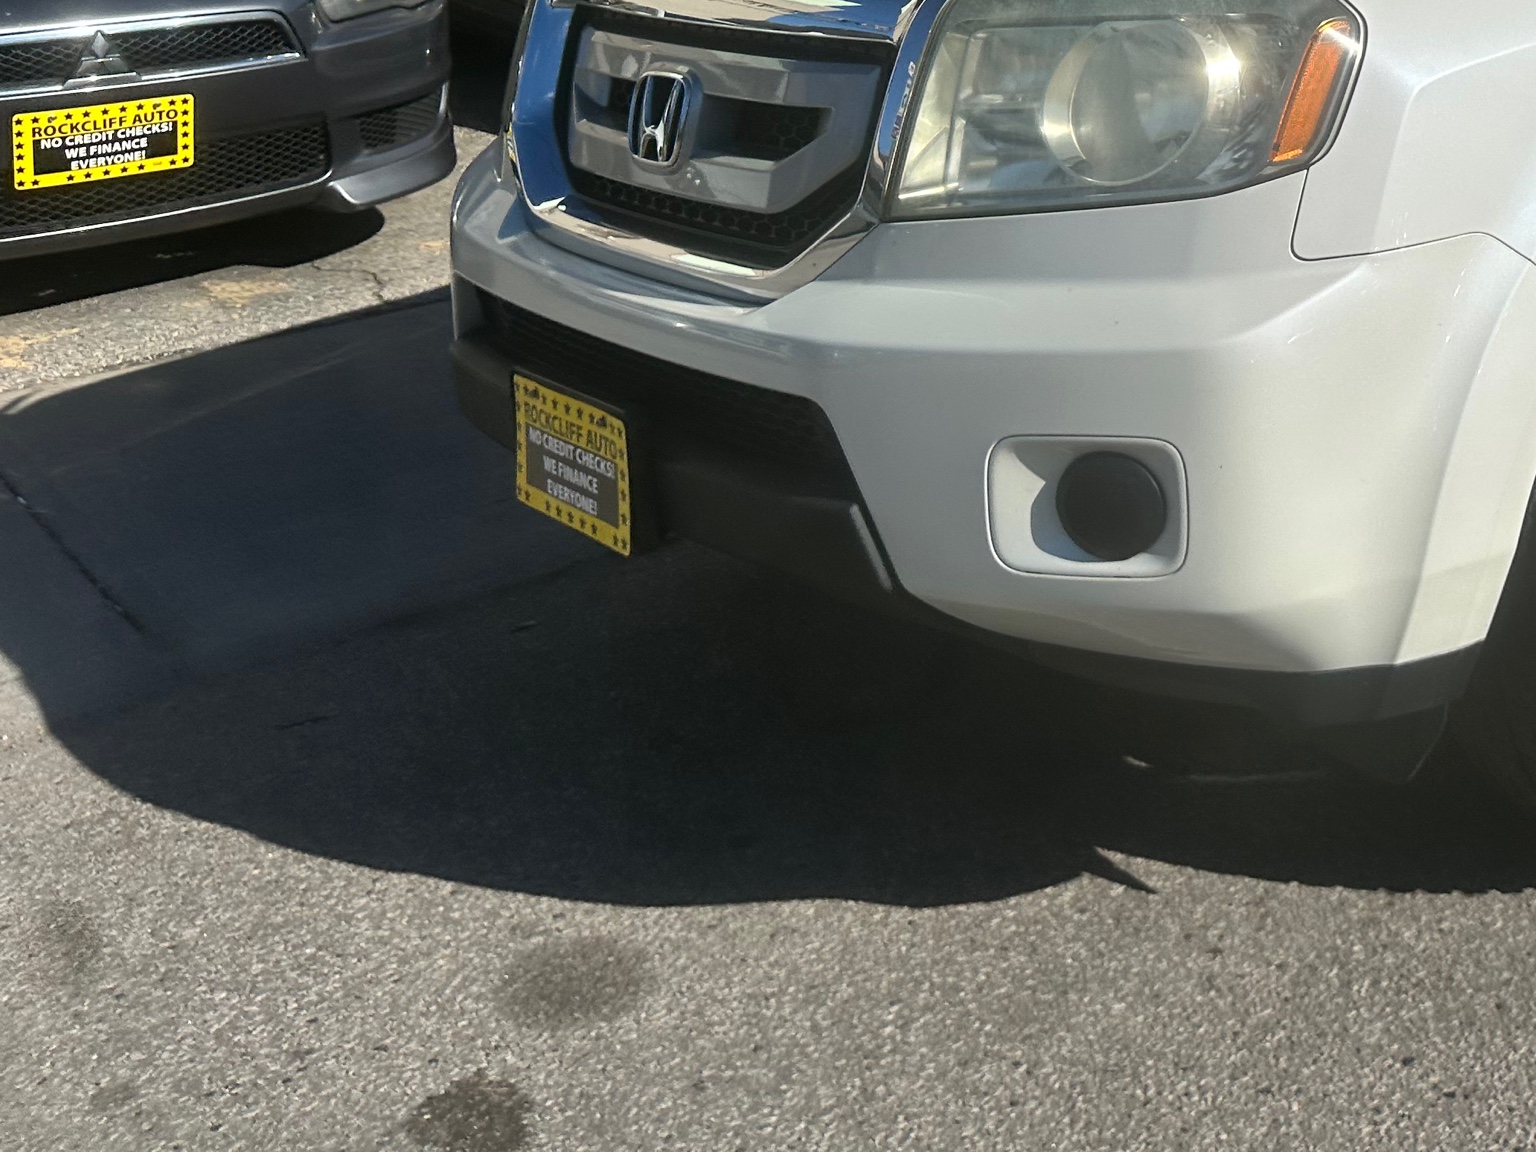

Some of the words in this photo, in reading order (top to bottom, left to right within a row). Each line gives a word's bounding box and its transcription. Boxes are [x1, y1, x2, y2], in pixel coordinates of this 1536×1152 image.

[32, 115, 127, 138] ROCKCLIFF
[132, 109, 178, 125] AUTO
[40, 137, 62, 149] NO
[65, 130, 114, 146] CREDIT
[117, 122, 173, 138] CHECKS!
[65, 148, 87, 159] WE
[90, 138, 148, 155] FINANCE
[70, 150, 146, 170] EVERYONE!
[524, 401, 584, 442] ROCKCLIFF
[586, 429, 618, 460] AUTO
[528, 427, 541, 445] NO
[542, 433, 575, 459] CREDIT
[575, 447, 615, 479] CHECKS!
[542, 454, 557, 474] WE
[558, 460, 599, 494] FINANCE
[546, 478, 598, 516] EVERYONE!
